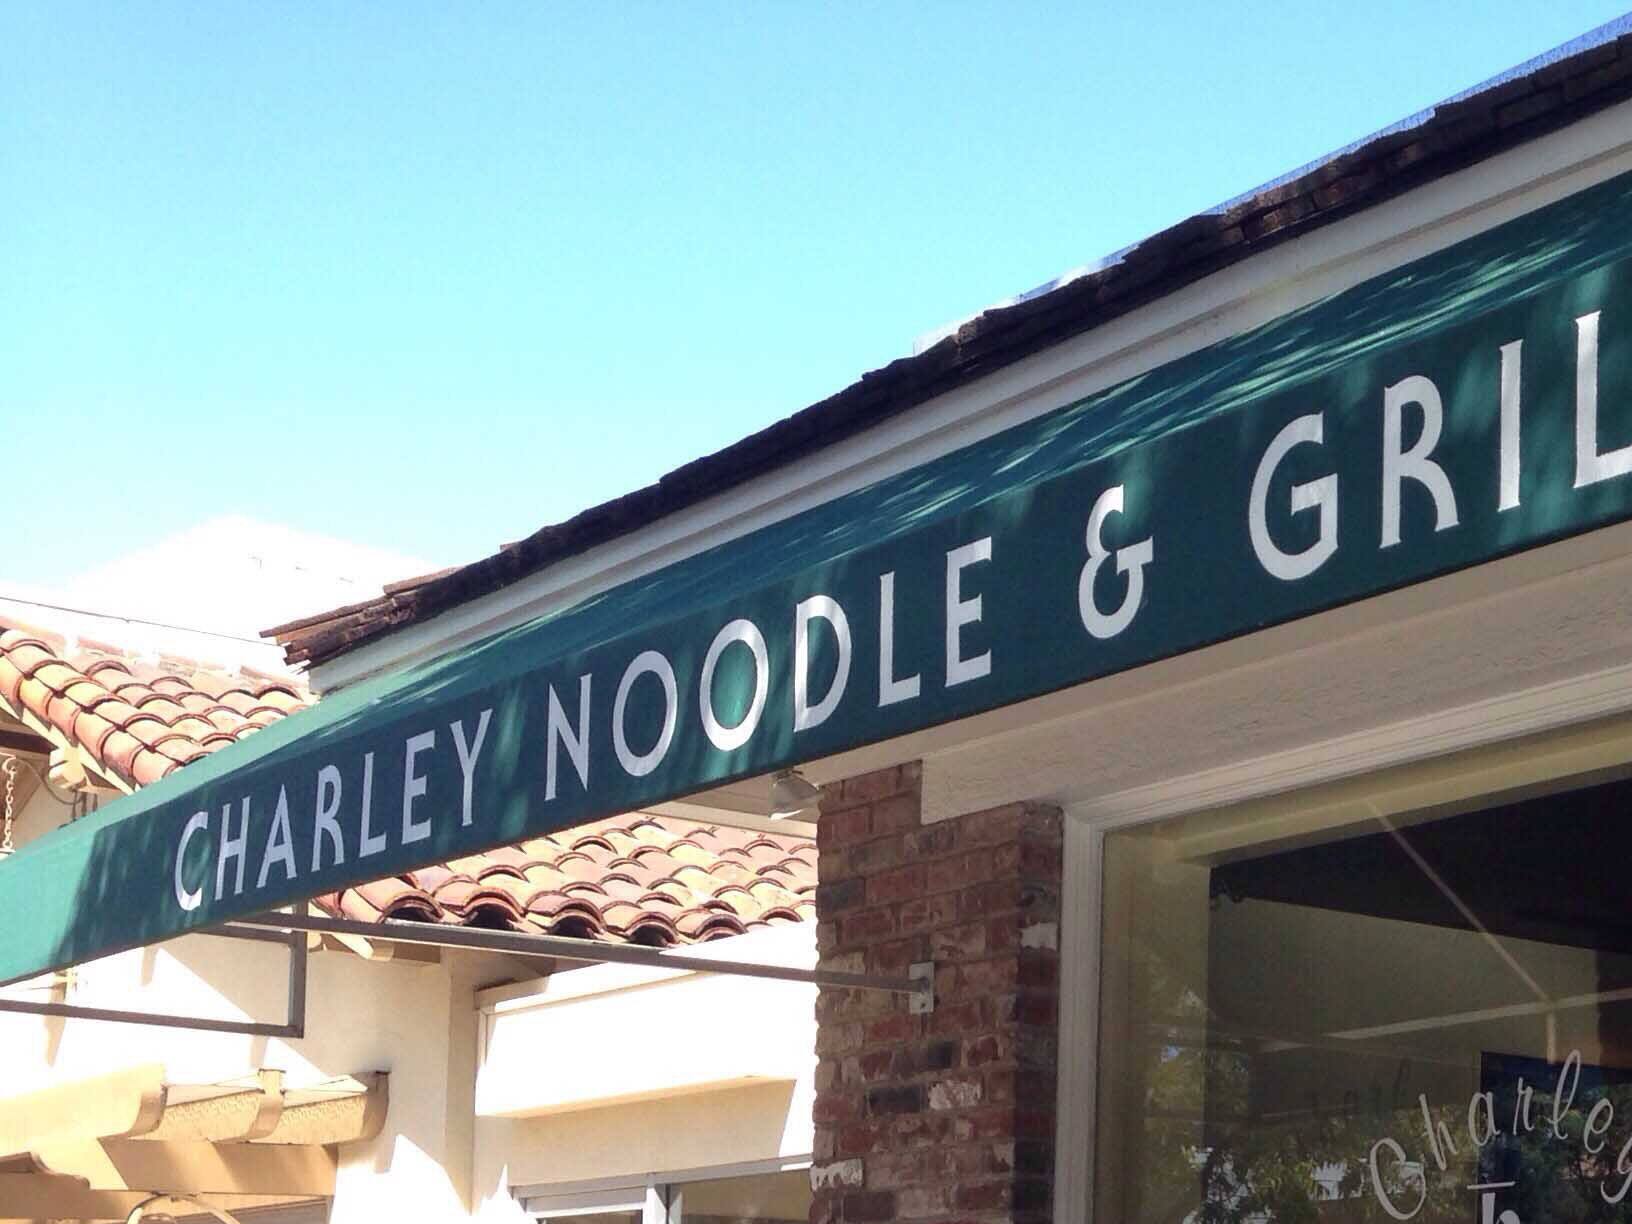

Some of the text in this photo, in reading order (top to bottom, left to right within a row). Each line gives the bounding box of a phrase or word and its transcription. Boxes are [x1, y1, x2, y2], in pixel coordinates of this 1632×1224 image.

[173, 709, 492, 911] CHARLEY
[544, 537, 992, 800] NOODLE
[1078, 484, 1153, 640] &
